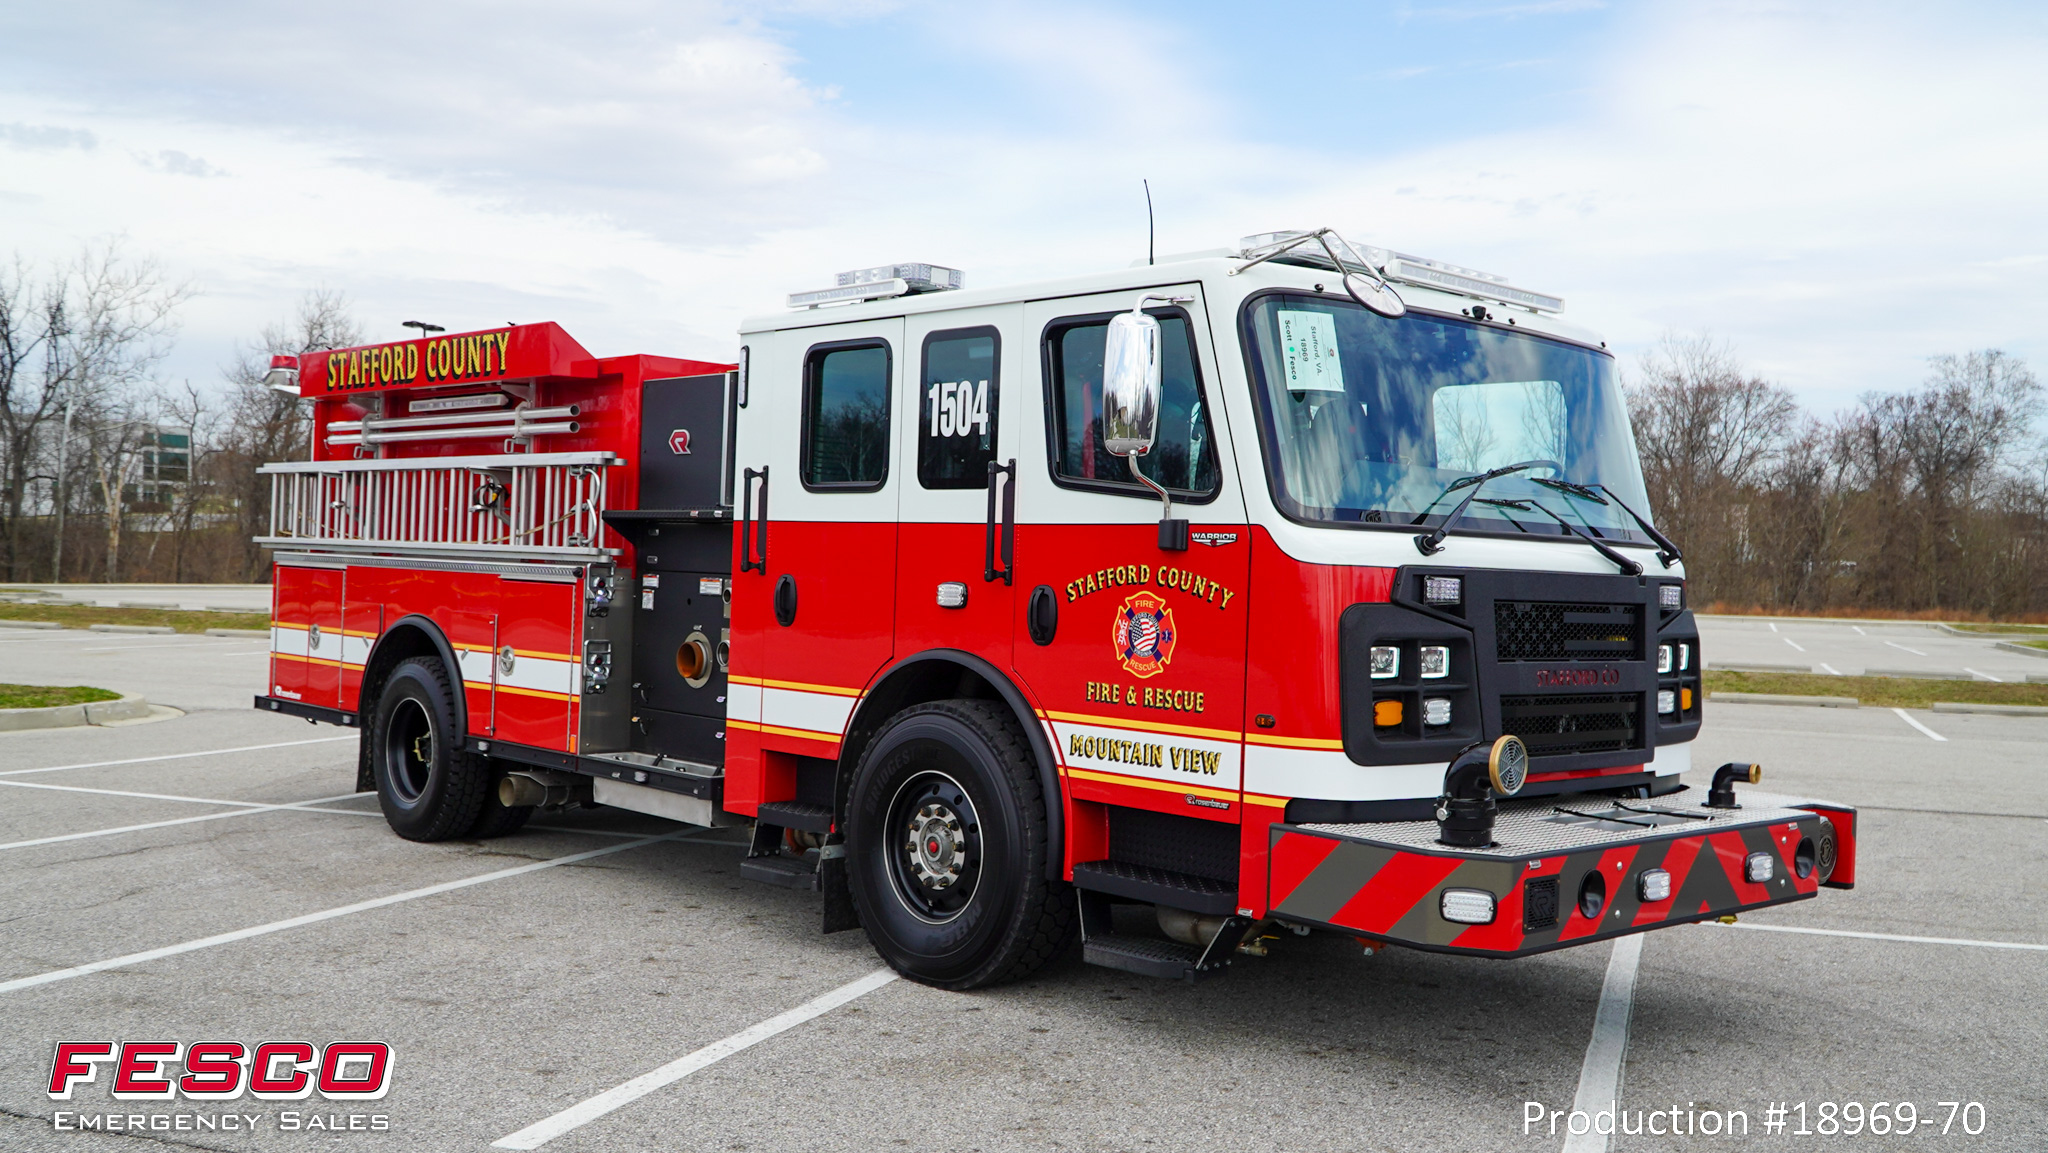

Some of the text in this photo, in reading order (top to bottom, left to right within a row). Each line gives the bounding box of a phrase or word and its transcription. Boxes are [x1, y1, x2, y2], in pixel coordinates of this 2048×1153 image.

[327, 331, 511, 391] STAFFORD COUNTY
[1285, 320, 1297, 380] Scott Fesco
[1300, 338, 1309, 362] 18969
[929, 380, 988, 437] 1504
[1191, 532, 1237, 540] WARRIOR
[1065, 564, 1235, 610] STAFFORD COUNTY
[1135, 600, 1155, 608] FIRE
[1129, 659, 1156, 671] RESCUE
[1537, 669, 1619, 687] STAFFORD CO
[1086, 681, 1205, 713] FIRE & RESCUE
[1069, 734, 1222, 775] MOUNTAIN VIEW
[866, 744, 944, 816] BRIDGESTE
[1195, 798, 1230, 810] rosenbauer
